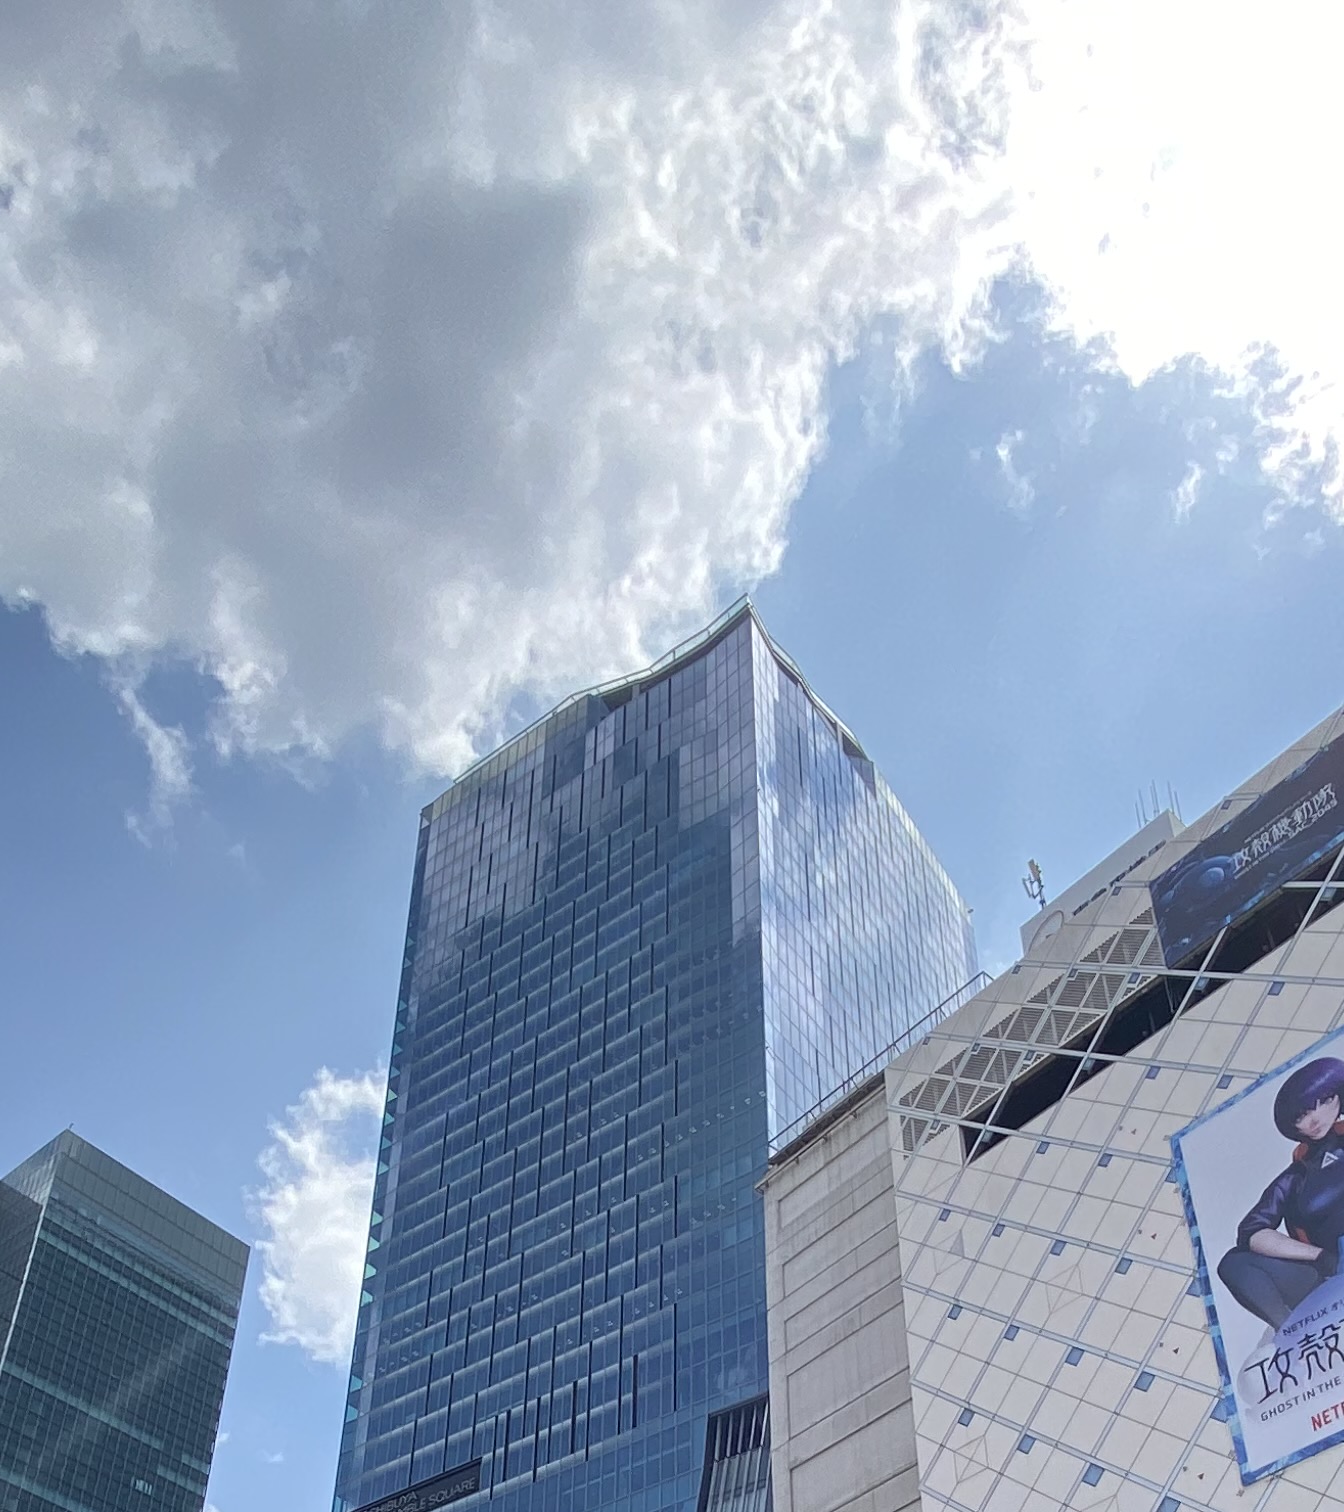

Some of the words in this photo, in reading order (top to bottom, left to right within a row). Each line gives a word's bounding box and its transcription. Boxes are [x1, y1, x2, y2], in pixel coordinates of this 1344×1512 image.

[1282, 1308, 1328, 1337] NETFLIX
[1260, 1394, 1305, 1422] GHOST
[1302, 1389, 1316, 1404] IN
[1316, 1375, 1342, 1398] THE
[427, 1477, 476, 1506] SQUARE
